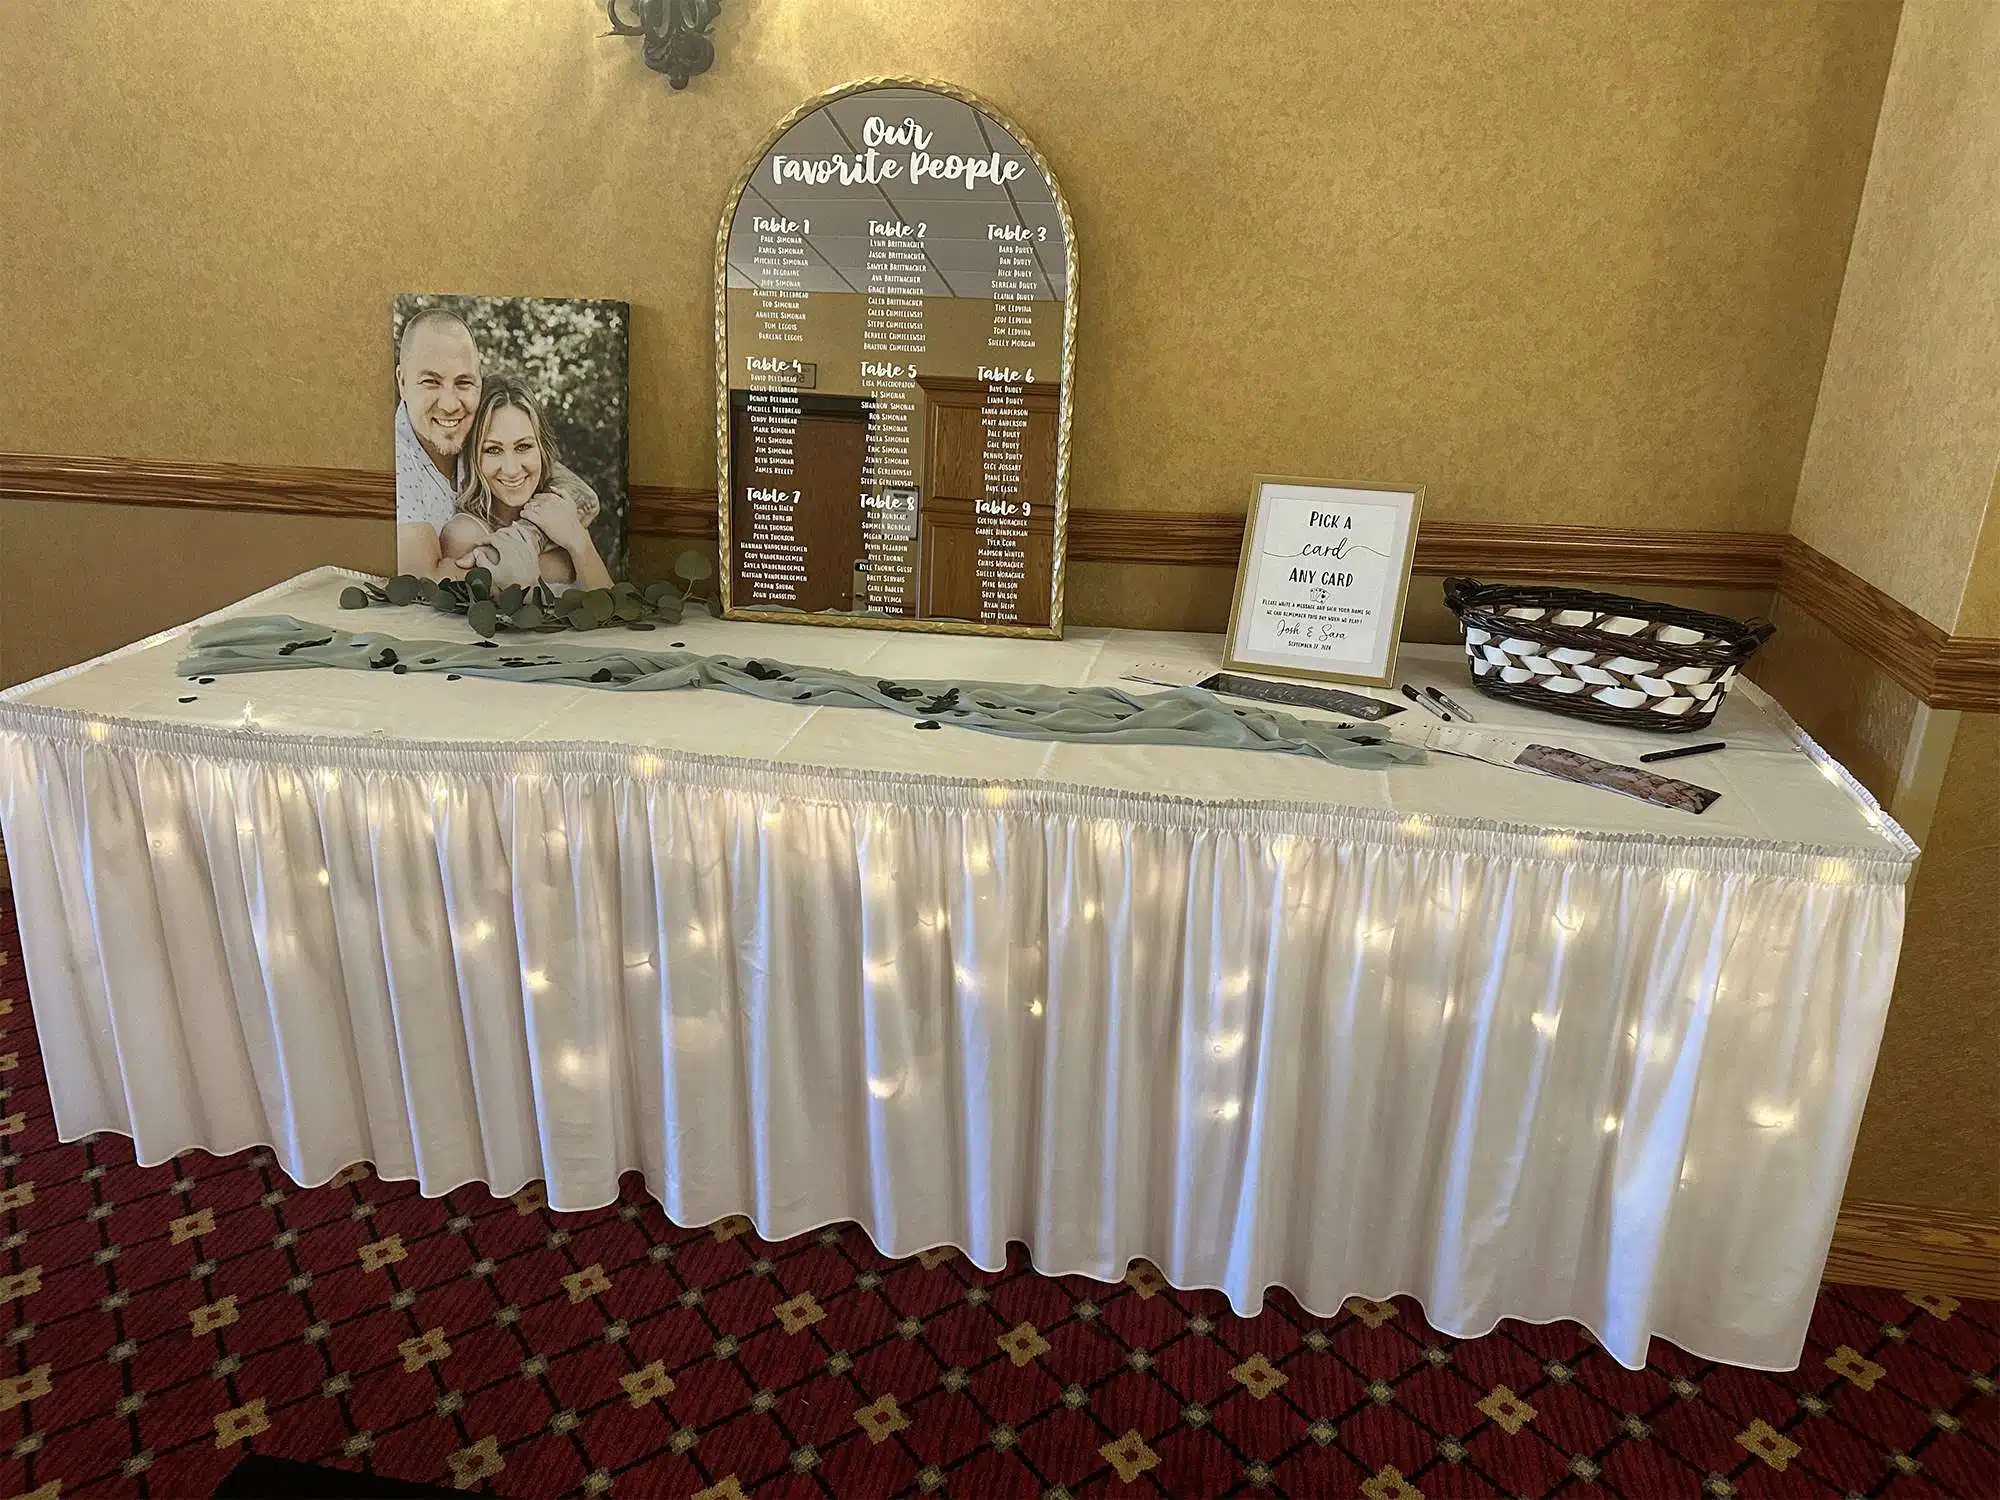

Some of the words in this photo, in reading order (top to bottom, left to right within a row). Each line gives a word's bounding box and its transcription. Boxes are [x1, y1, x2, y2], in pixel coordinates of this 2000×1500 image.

[862, 116, 933, 150] Our
[773, 148, 903, 186] Favorite
[910, 152, 1025, 190] People
[753, 217, 800, 233] Table
[804, 219, 809, 234] 1
[868, 221, 914, 238] Table
[917, 222, 927, 238] 2
[987, 224, 1034, 241] Table
[1037, 227, 1047, 241] 3
[745, 357, 790, 372] Table
[793, 359, 801, 373] 4
[860, 362, 904, 378] Table
[908, 364, 917, 379] 5
[977, 366, 1021, 383] Table
[1025, 368, 1035, 383] 6
[746, 488, 789, 503] Table
[793, 490, 801, 504] 7
[860, 494, 903, 509] Table
[906, 497, 915, 511] 8
[975, 500, 1018, 516] Table
[1022, 502, 1031, 516] 9
[1309, 511, 1339, 528] PICK
[1344, 516, 1352, 529] A
[1288, 567, 1316, 584] ANY
[1321, 571, 1354, 587] CARD
[1276, 619, 1300, 637] Josh
